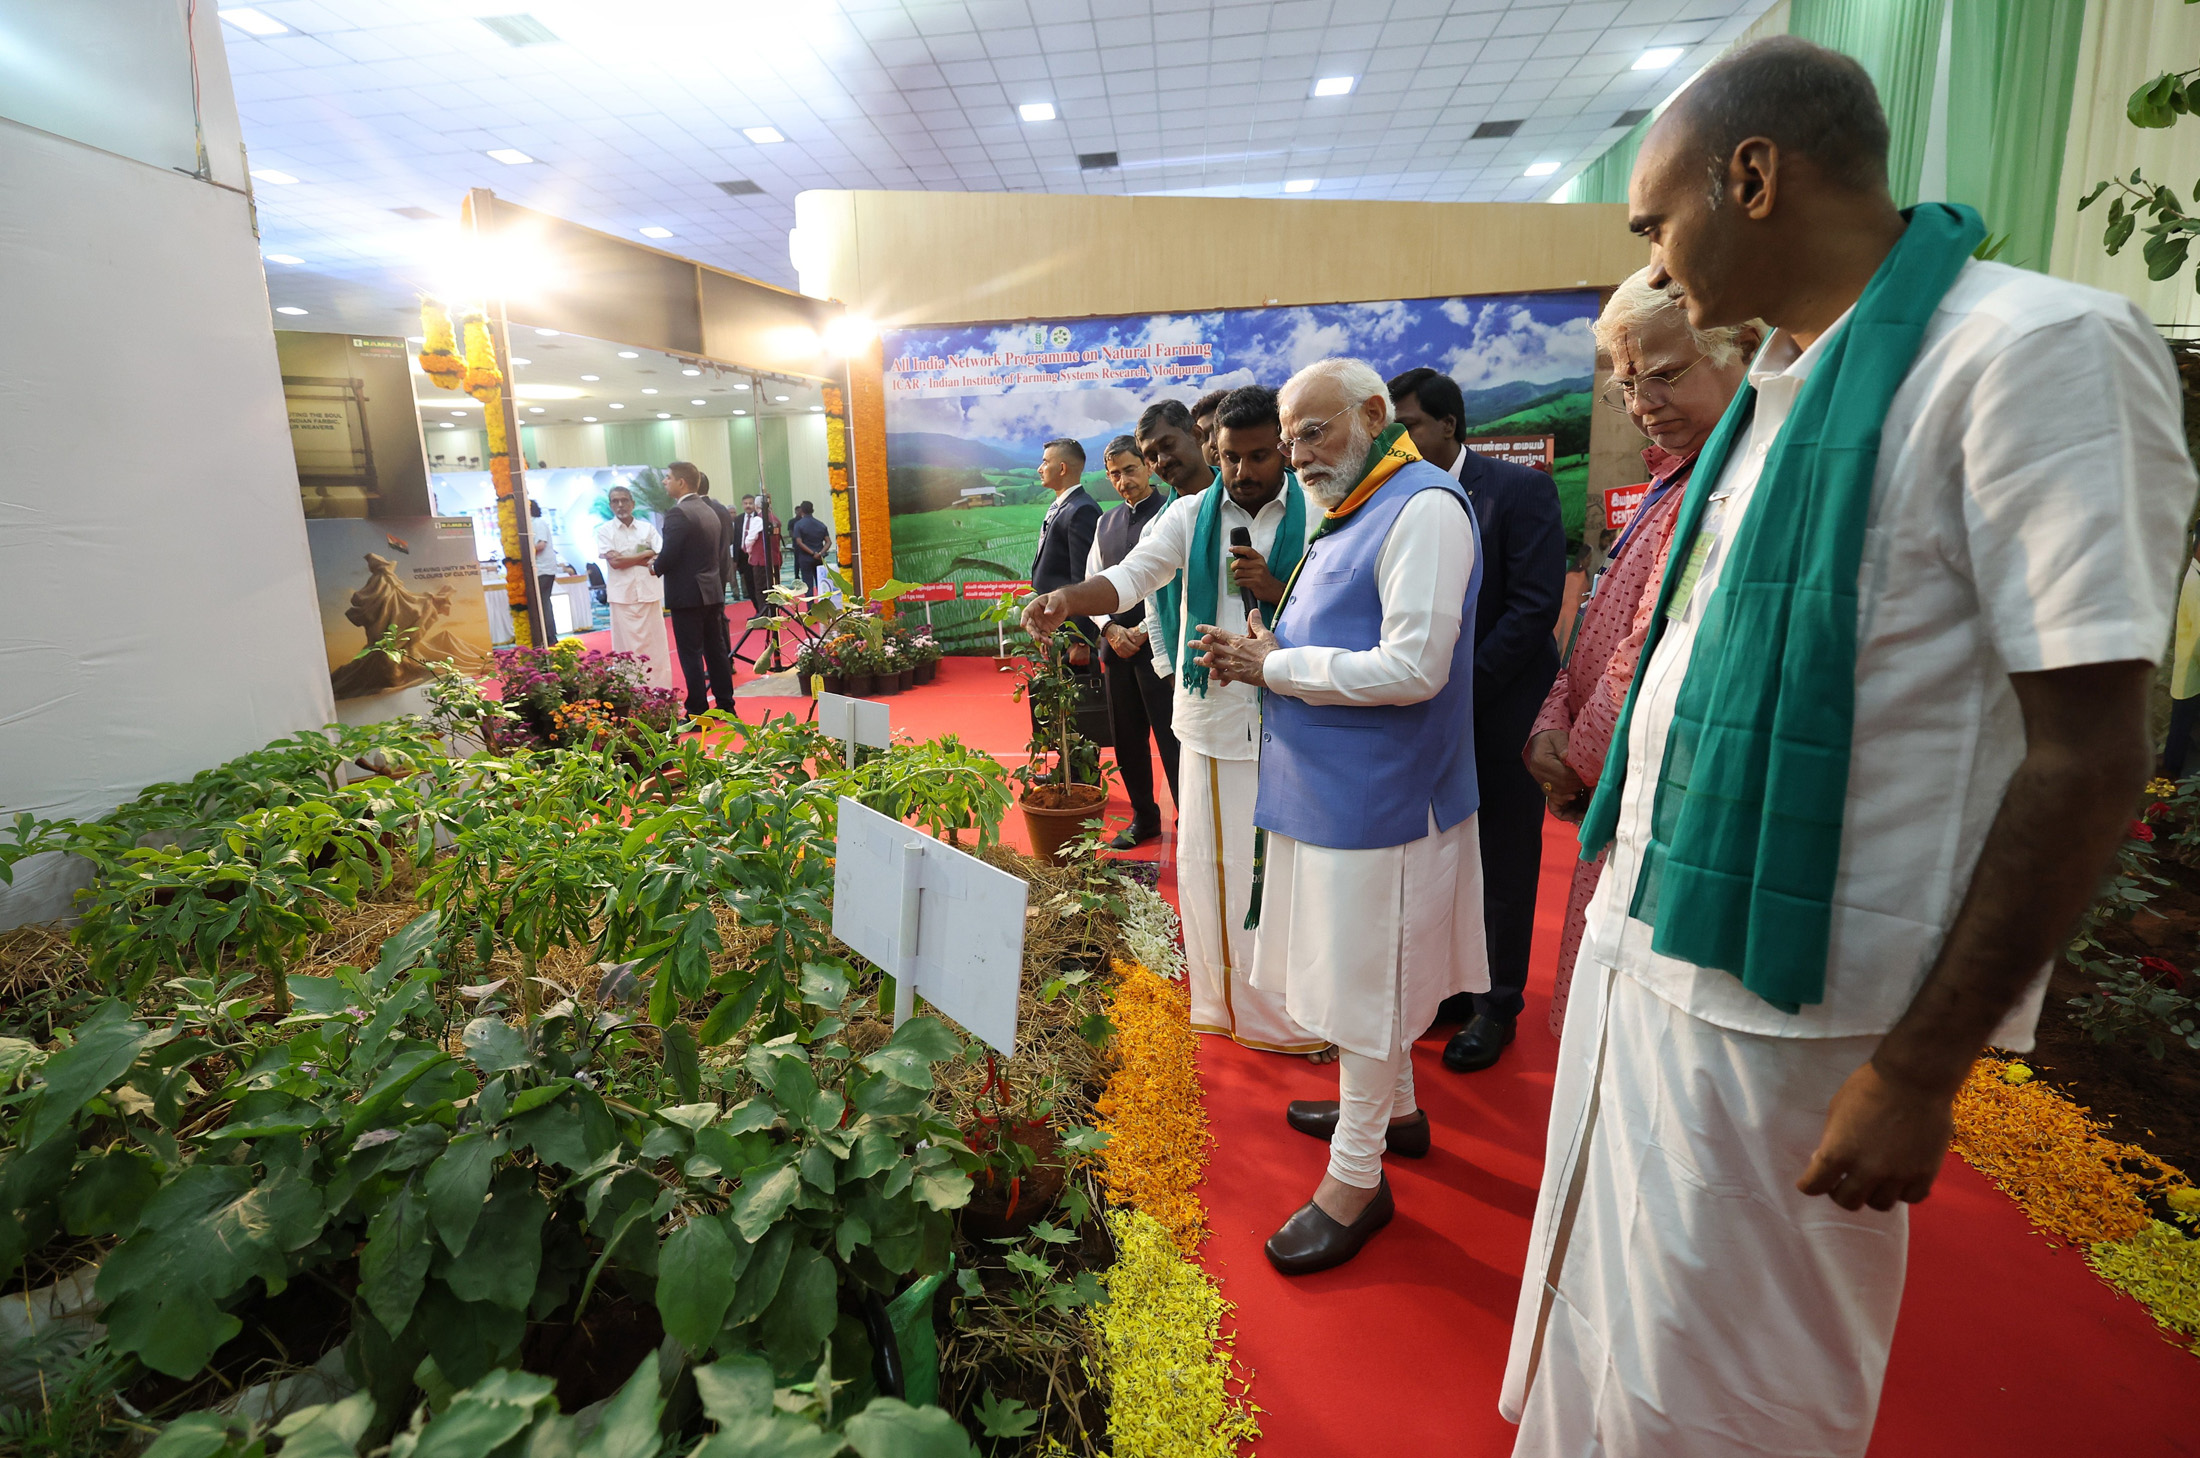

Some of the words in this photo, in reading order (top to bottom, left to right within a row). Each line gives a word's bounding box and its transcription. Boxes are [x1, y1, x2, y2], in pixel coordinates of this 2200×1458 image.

[892, 358, 910, 372] All
[912, 354, 945, 371] India
[949, 353, 1001, 369] Network
[1005, 349, 1080, 367] Programme
[1082, 351, 1098, 362] on
[1102, 344, 1151, 360] Natural
[1155, 341, 1212, 358] Farming
[892, 378, 920, 391] ICAR
[929, 374, 960, 389] Indian
[962, 372, 1002, 387] Institute
[1005, 372, 1015, 384] of
[1016, 369, 1058, 384] Farming
[1060, 368, 1099, 384] Systems
[1102, 365, 1151, 380] Research,
[1152, 362, 1213, 379] Modipuram
[1512, 438, 1545, 451] மையம்
[413, 566, 441, 574] WEAVING
